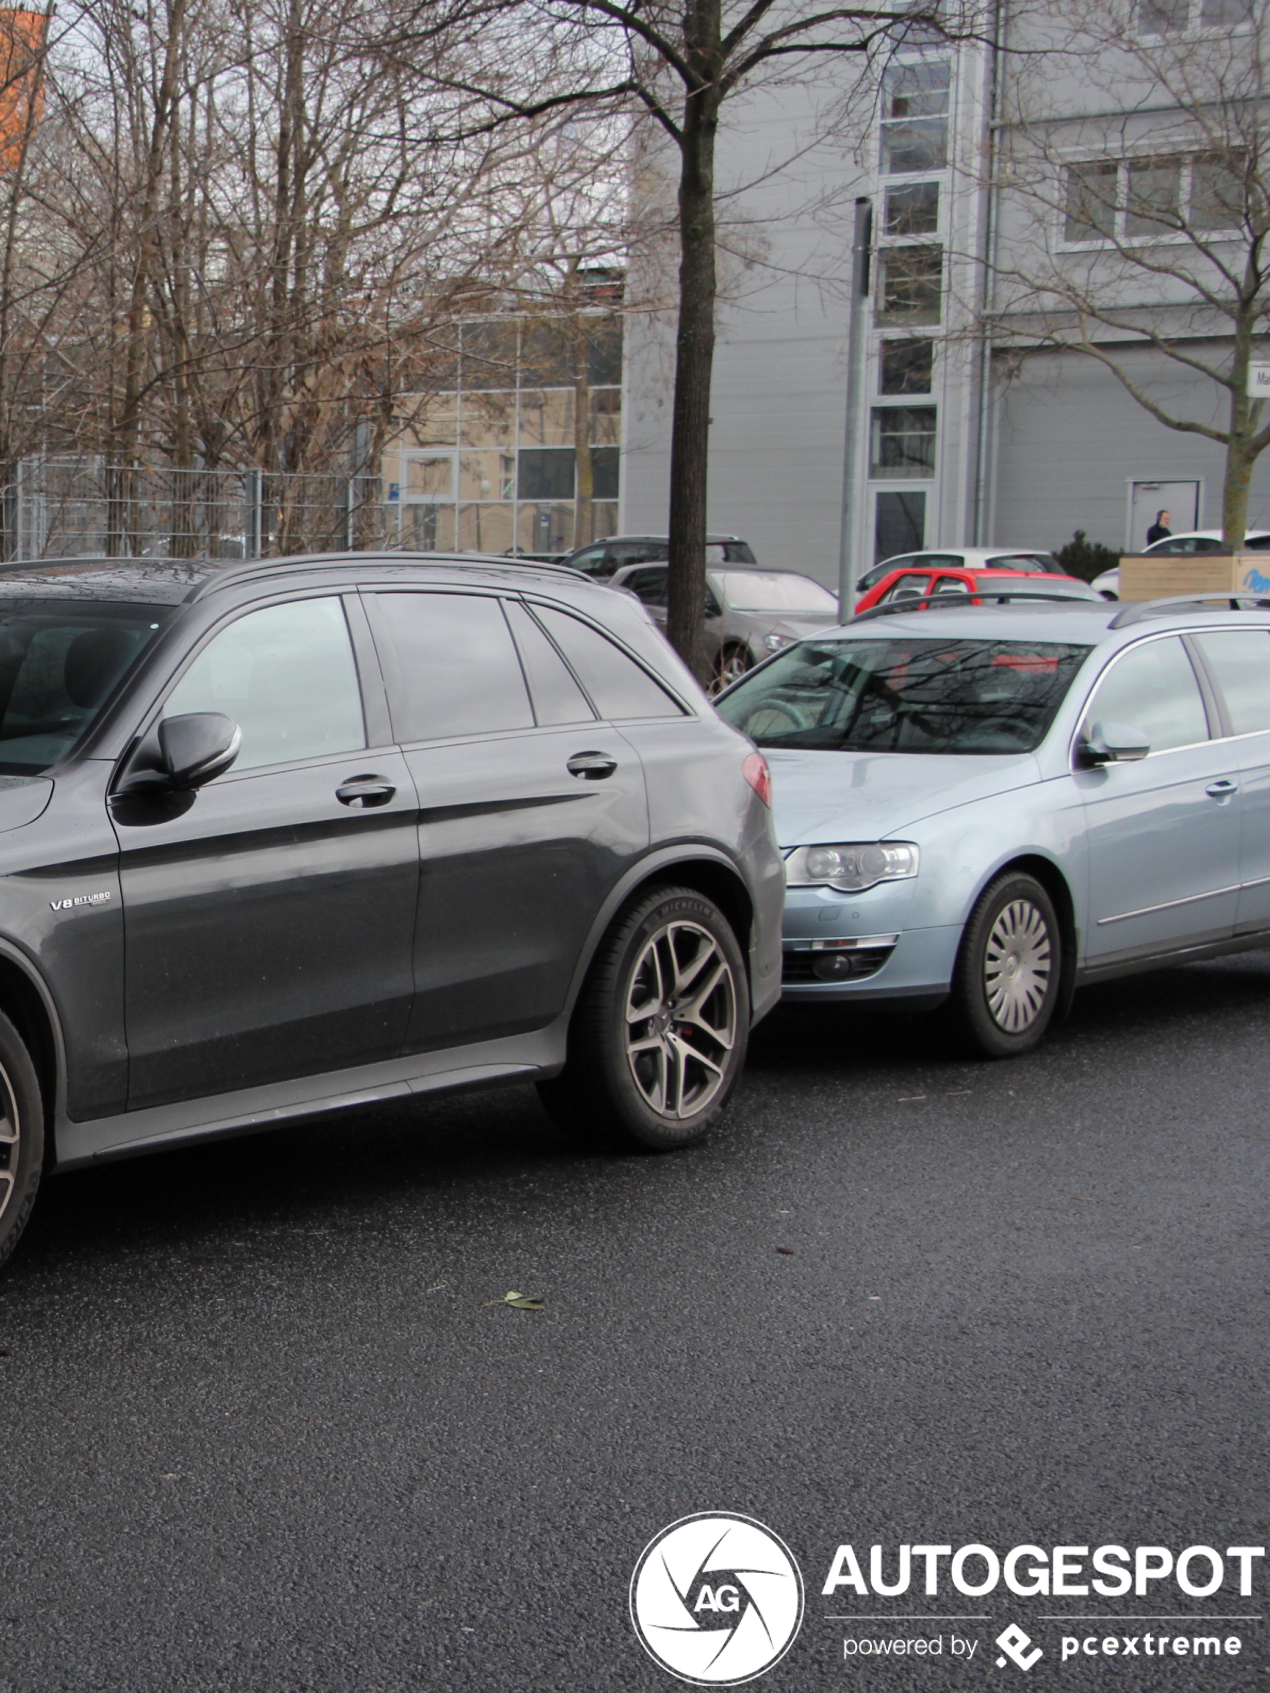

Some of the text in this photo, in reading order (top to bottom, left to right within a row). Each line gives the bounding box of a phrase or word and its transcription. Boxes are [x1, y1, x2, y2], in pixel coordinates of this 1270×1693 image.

[50, 891, 110, 911] V8 BITURBO
[661, 901, 711, 915] MICHELIN
